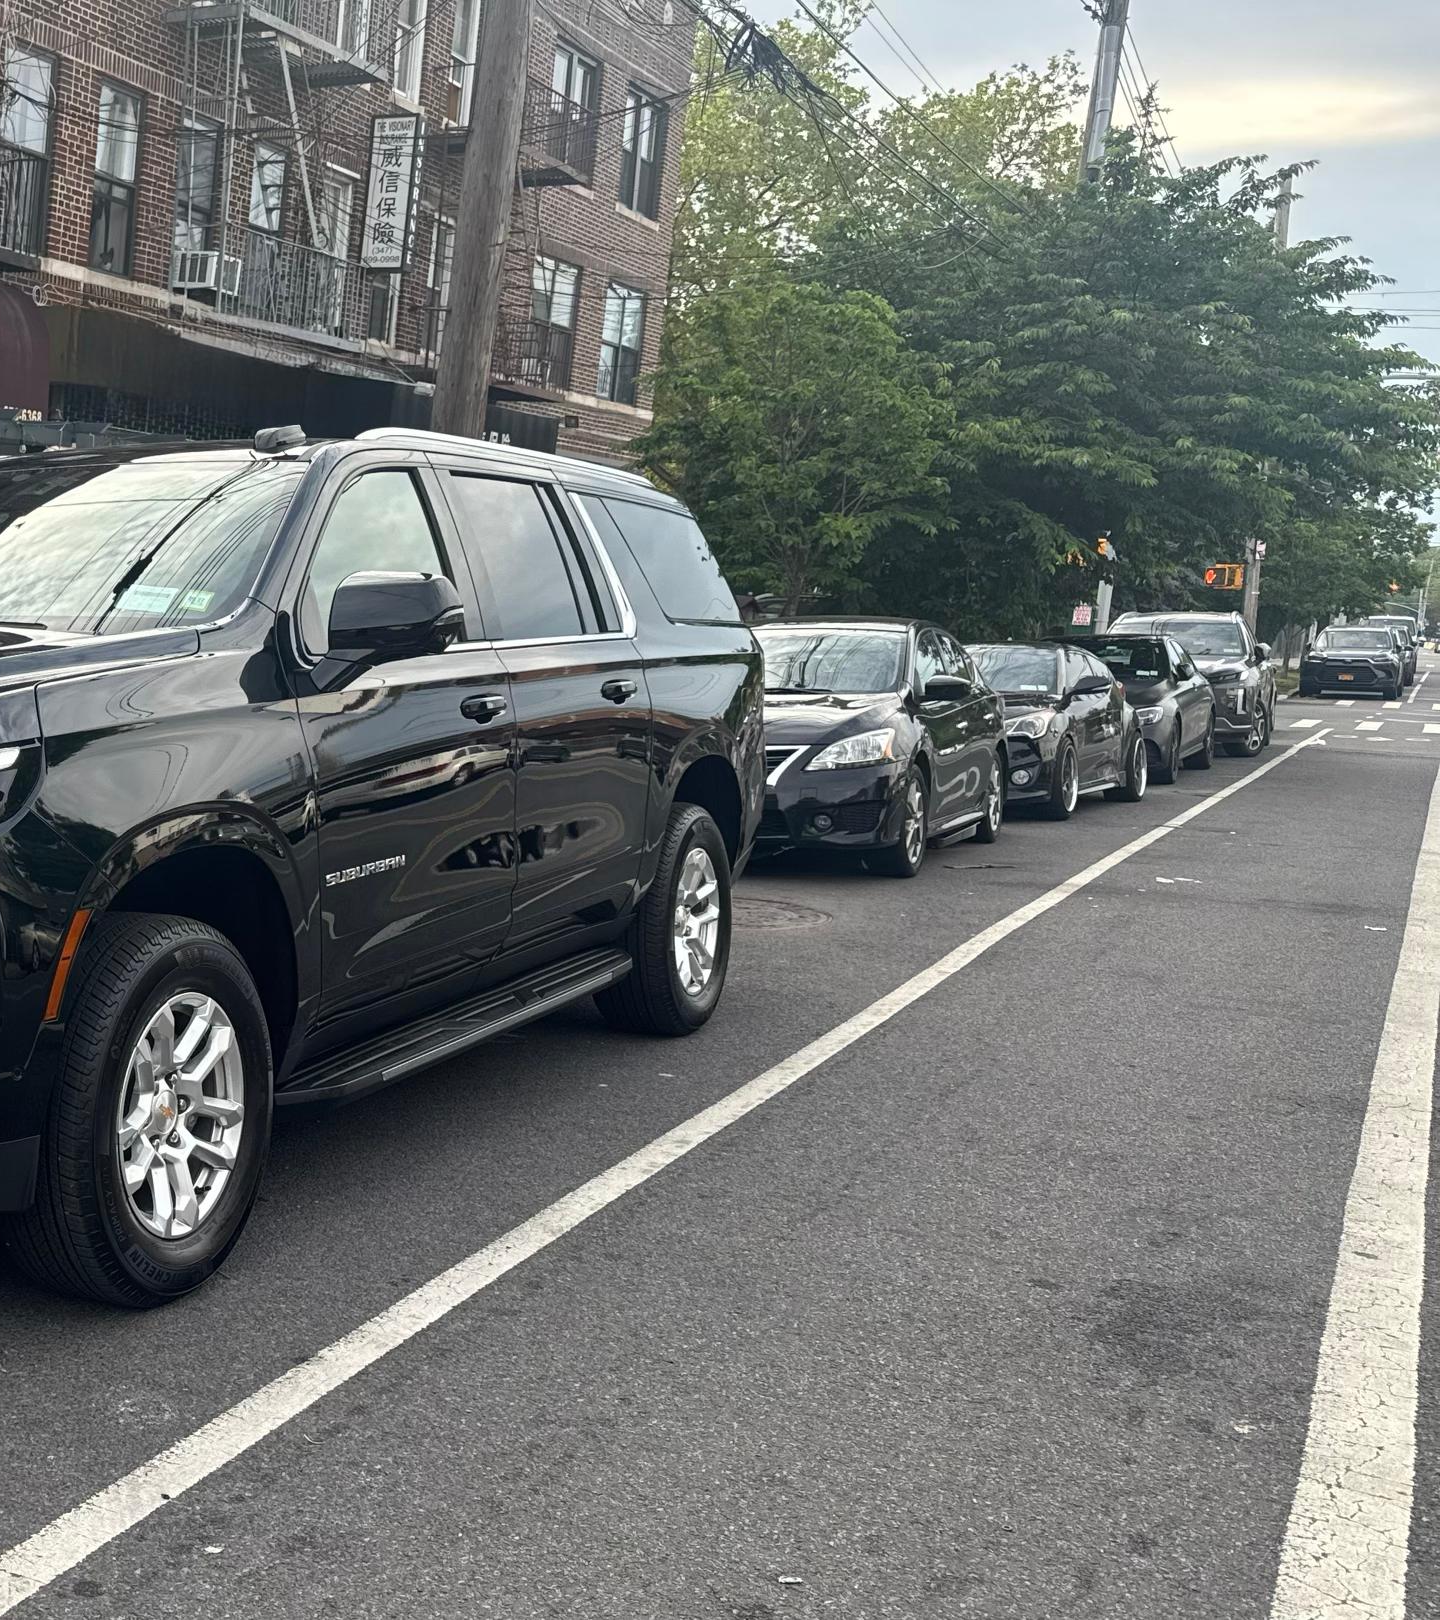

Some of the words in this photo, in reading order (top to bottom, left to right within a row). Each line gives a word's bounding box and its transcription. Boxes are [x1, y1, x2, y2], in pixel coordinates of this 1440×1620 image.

[372, 145, 403, 244] 威信保險
[406, 122, 425, 264] INSURANCE
[325, 855, 406, 887] SUBURBAN
